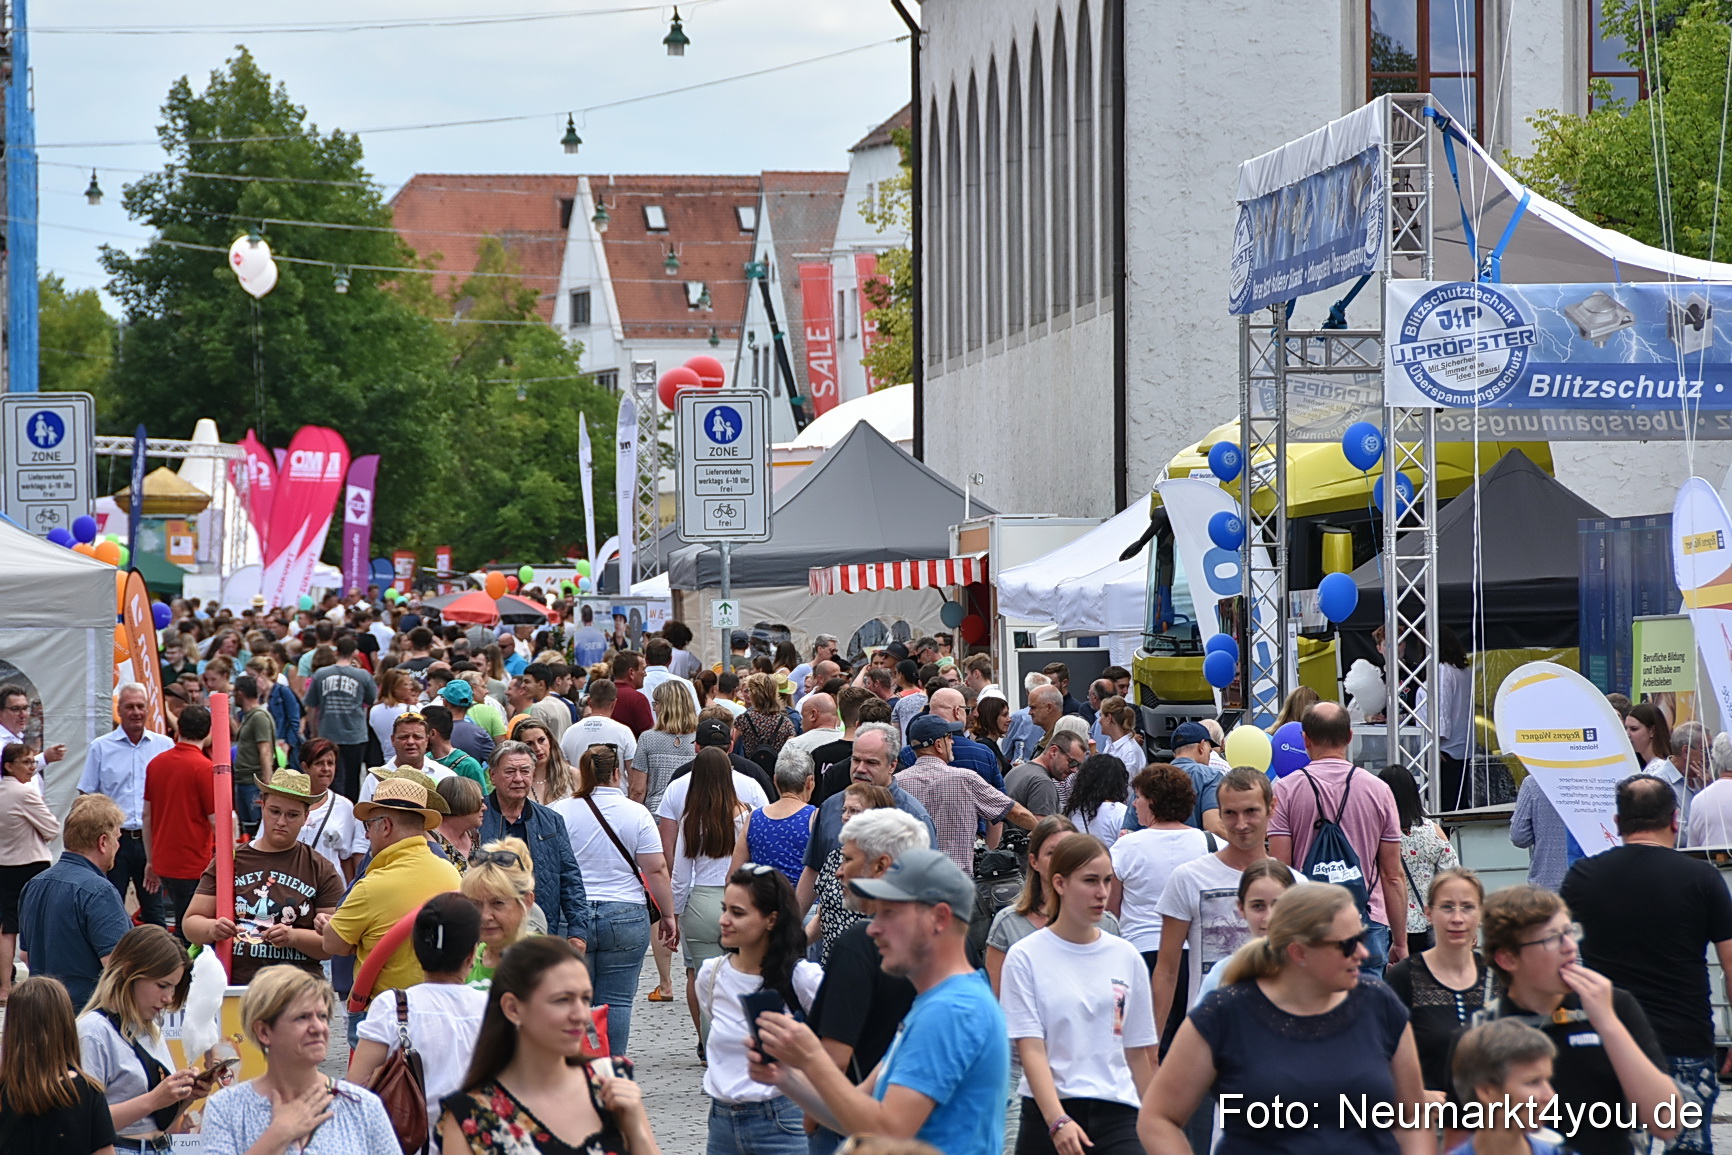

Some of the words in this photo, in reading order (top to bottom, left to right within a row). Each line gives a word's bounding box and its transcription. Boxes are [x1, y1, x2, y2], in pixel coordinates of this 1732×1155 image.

[1404, 285, 1516, 338] Blitzschutztechnik
[1395, 329, 1536, 363] J.PRÖPSTER
[806, 326, 835, 398] SALE
[1408, 355, 1524, 404] Überspannungsschutz
[1528, 374, 1705, 399] Blitzschutz
[31, 451, 61, 461] ZONE
[709, 446, 739, 457] ZONE
[1643, 653, 1667, 662] Berufliche
[1668, 651, 1686, 663] Bildung
[1643, 666, 1653, 675] und
[1653, 664, 1673, 674] Teilhabe
[322, 674, 341, 696] LIVE
[341, 674, 359, 697] FAST
[1643, 677, 1672, 687] Arbeitsleben
[270, 870, 317, 899] FRIEND
[181, 1139, 200, 1147] zum
